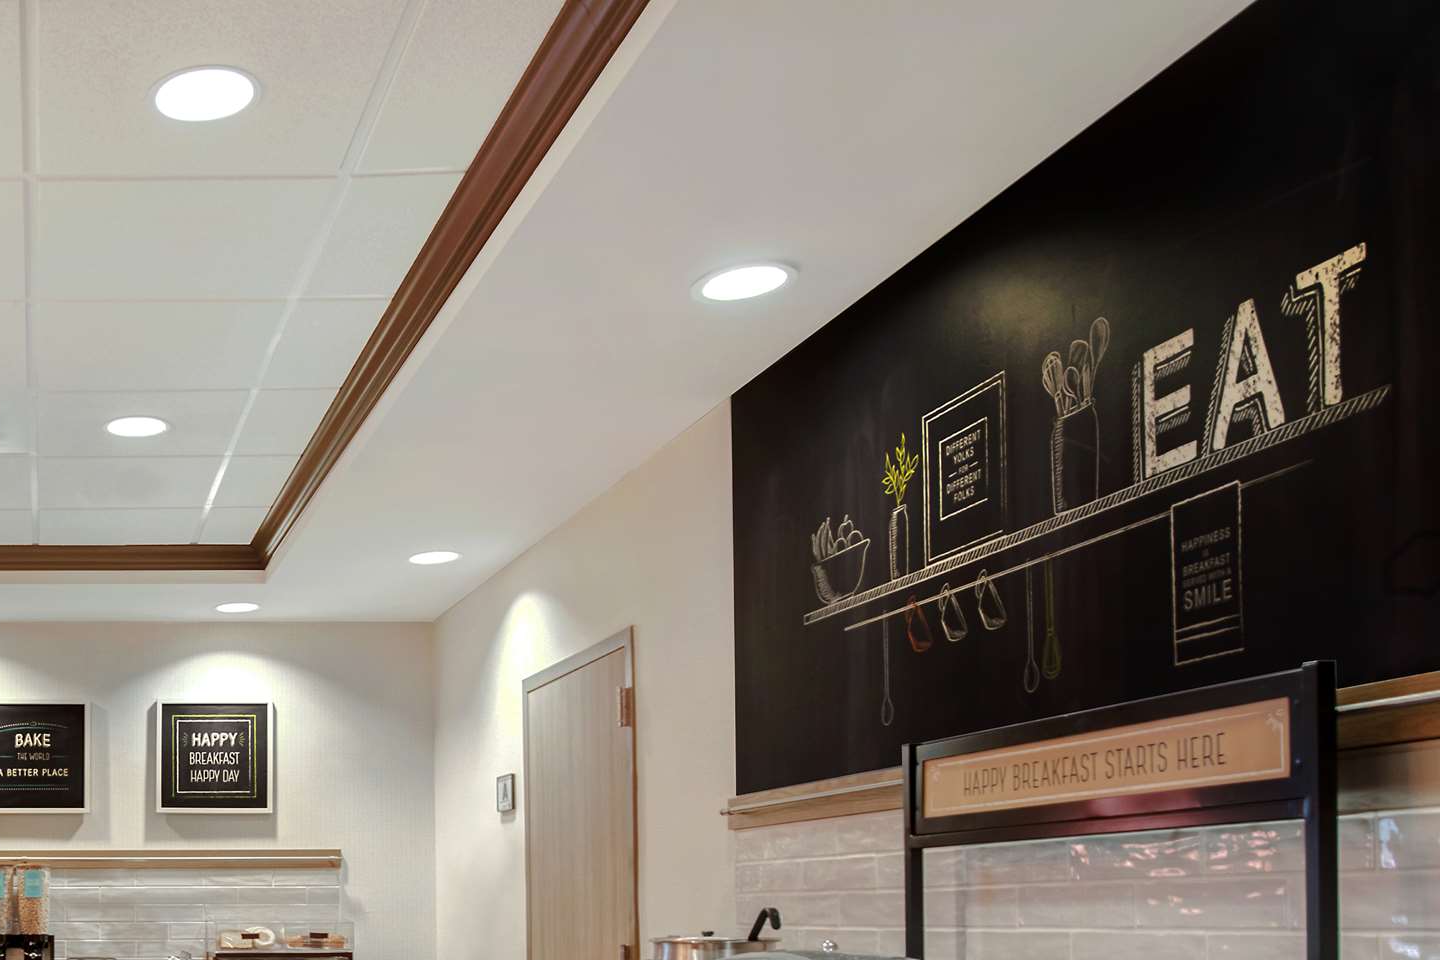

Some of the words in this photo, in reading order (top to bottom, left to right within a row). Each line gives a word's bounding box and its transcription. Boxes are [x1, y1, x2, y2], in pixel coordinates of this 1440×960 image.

[1133, 241, 1367, 481] EAT
[945, 429, 981, 456] DIFFERENT
[953, 446, 975, 464] YOLKS
[946, 468, 982, 495] DIFFERENT
[953, 485, 975, 504] FOLKS
[1183, 578, 1233, 611] SMILE
[14, 733, 52, 748] BAKE
[191, 731, 238, 747] HAPPY
[16, 752, 27, 760] THE
[29, 752, 50, 761] WORLD
[189, 751, 241, 766] BREAKFAST
[963, 765, 1008, 797] HAPPY
[1012, 752, 1099, 792] BREAKFAST
[1104, 742, 1169, 780] STARTS
[1176, 732, 1228, 771] HERE
[6, 768, 39, 777] BETTER
[42, 768, 69, 777] PLACE
[190, 769, 221, 783] HAPPY
[222, 769, 240, 783] DAY
